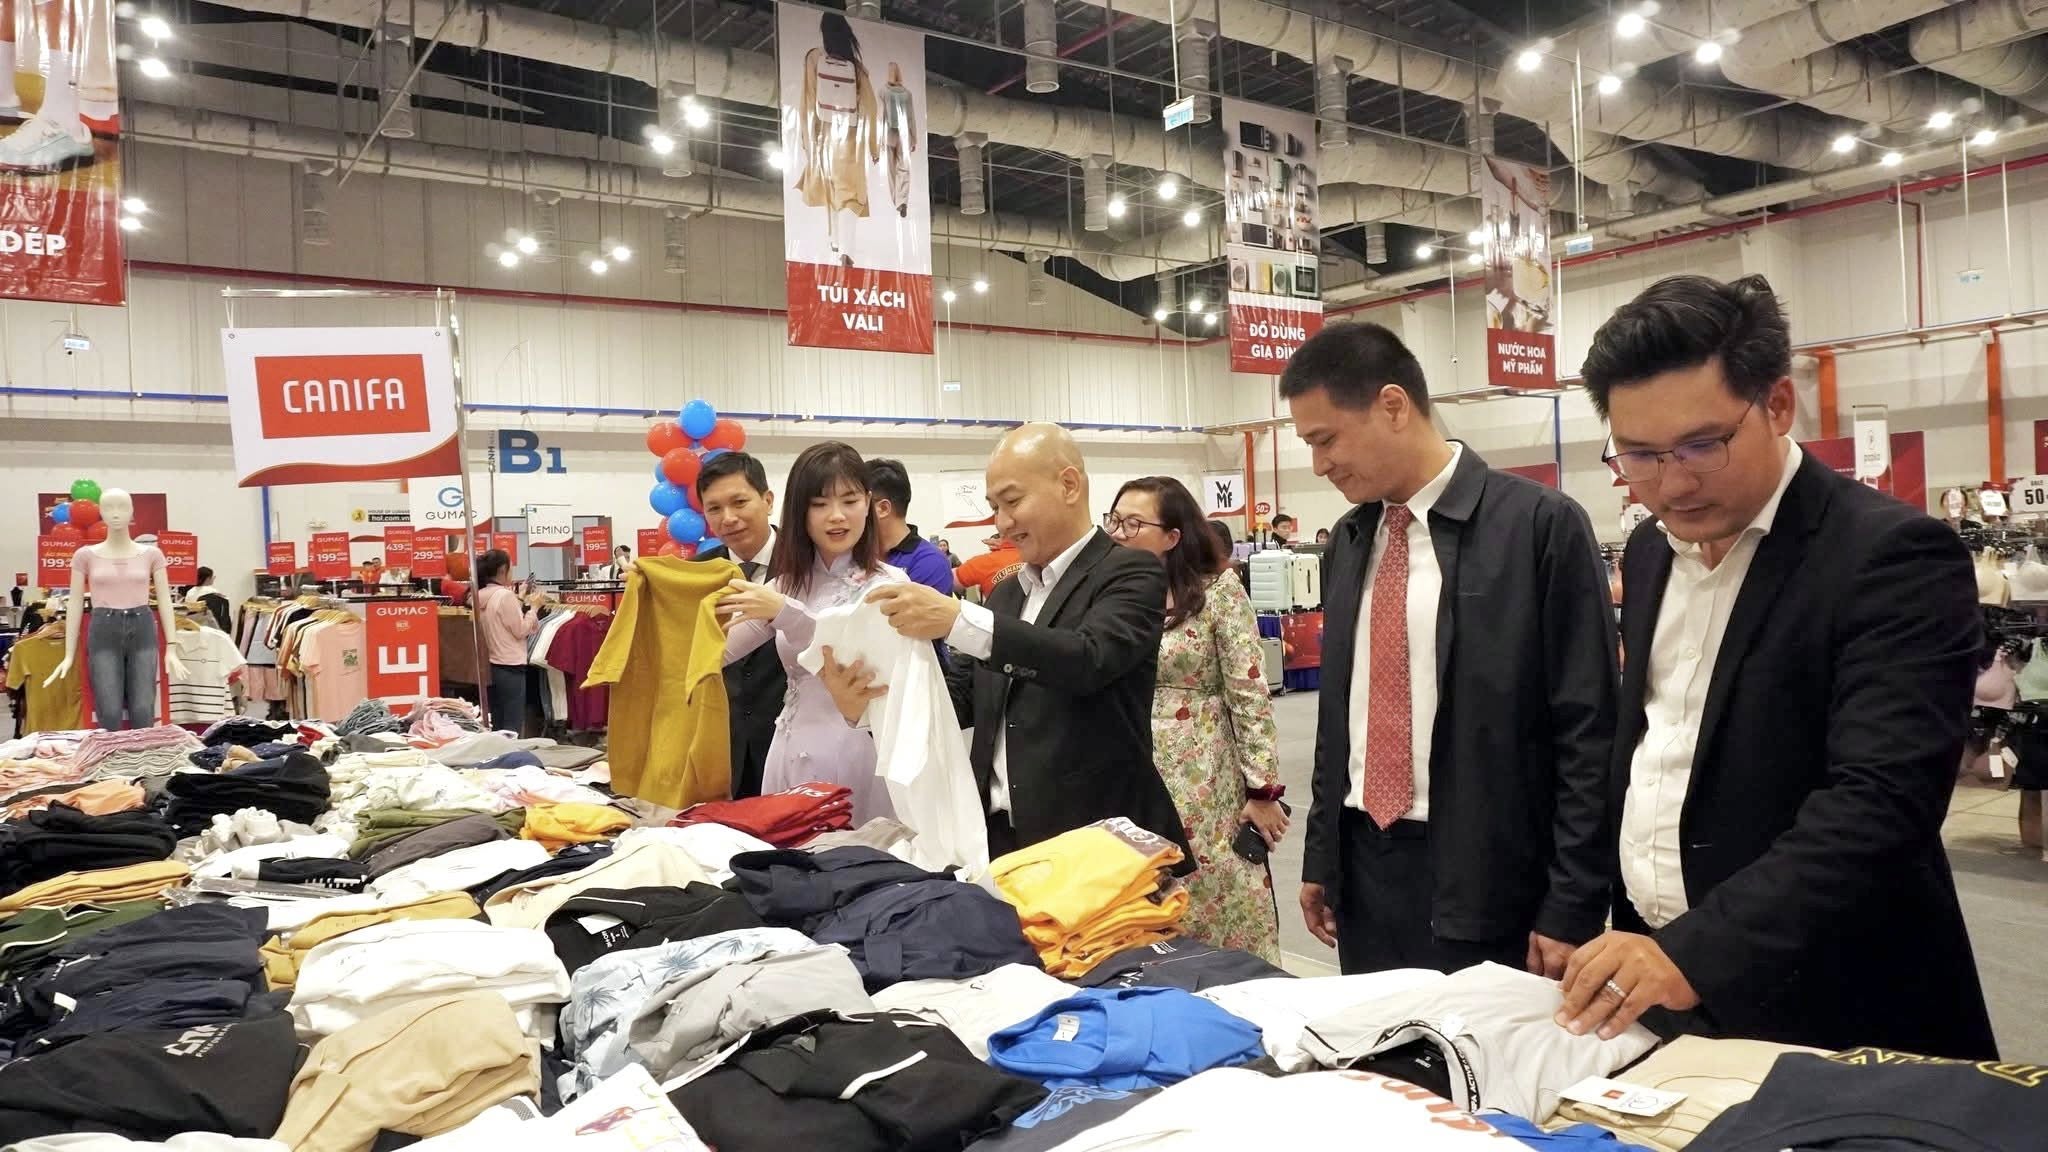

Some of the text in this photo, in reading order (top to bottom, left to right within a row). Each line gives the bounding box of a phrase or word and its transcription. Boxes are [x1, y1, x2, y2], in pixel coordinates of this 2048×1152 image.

[0, 226, 66, 256] DÉP
[817, 281, 905, 308] TÚI XÁCH
[842, 312, 883, 331] VALI
[1271, 323, 1306, 341] DÙNG
[1251, 343, 1296, 359] GIA ĐÌN
[1527, 346, 1546, 359] HOA
[1503, 358, 1516, 373] MỸ
[282, 377, 406, 414] CANIFA
[498, 429, 567, 474] B1
[2024, 488, 2048, 505] 50
[530, 525, 570, 535] LEMINO
[585, 543, 600, 551] 199
[40, 558, 65, 568] 199
[166, 556, 182, 566] 99
[317, 553, 337, 562] 199
[413, 551, 433, 560] 299
[567, 594, 607, 604] GUMAC
[376, 606, 429, 617] GUMAC
[378, 643, 429, 706] LE
